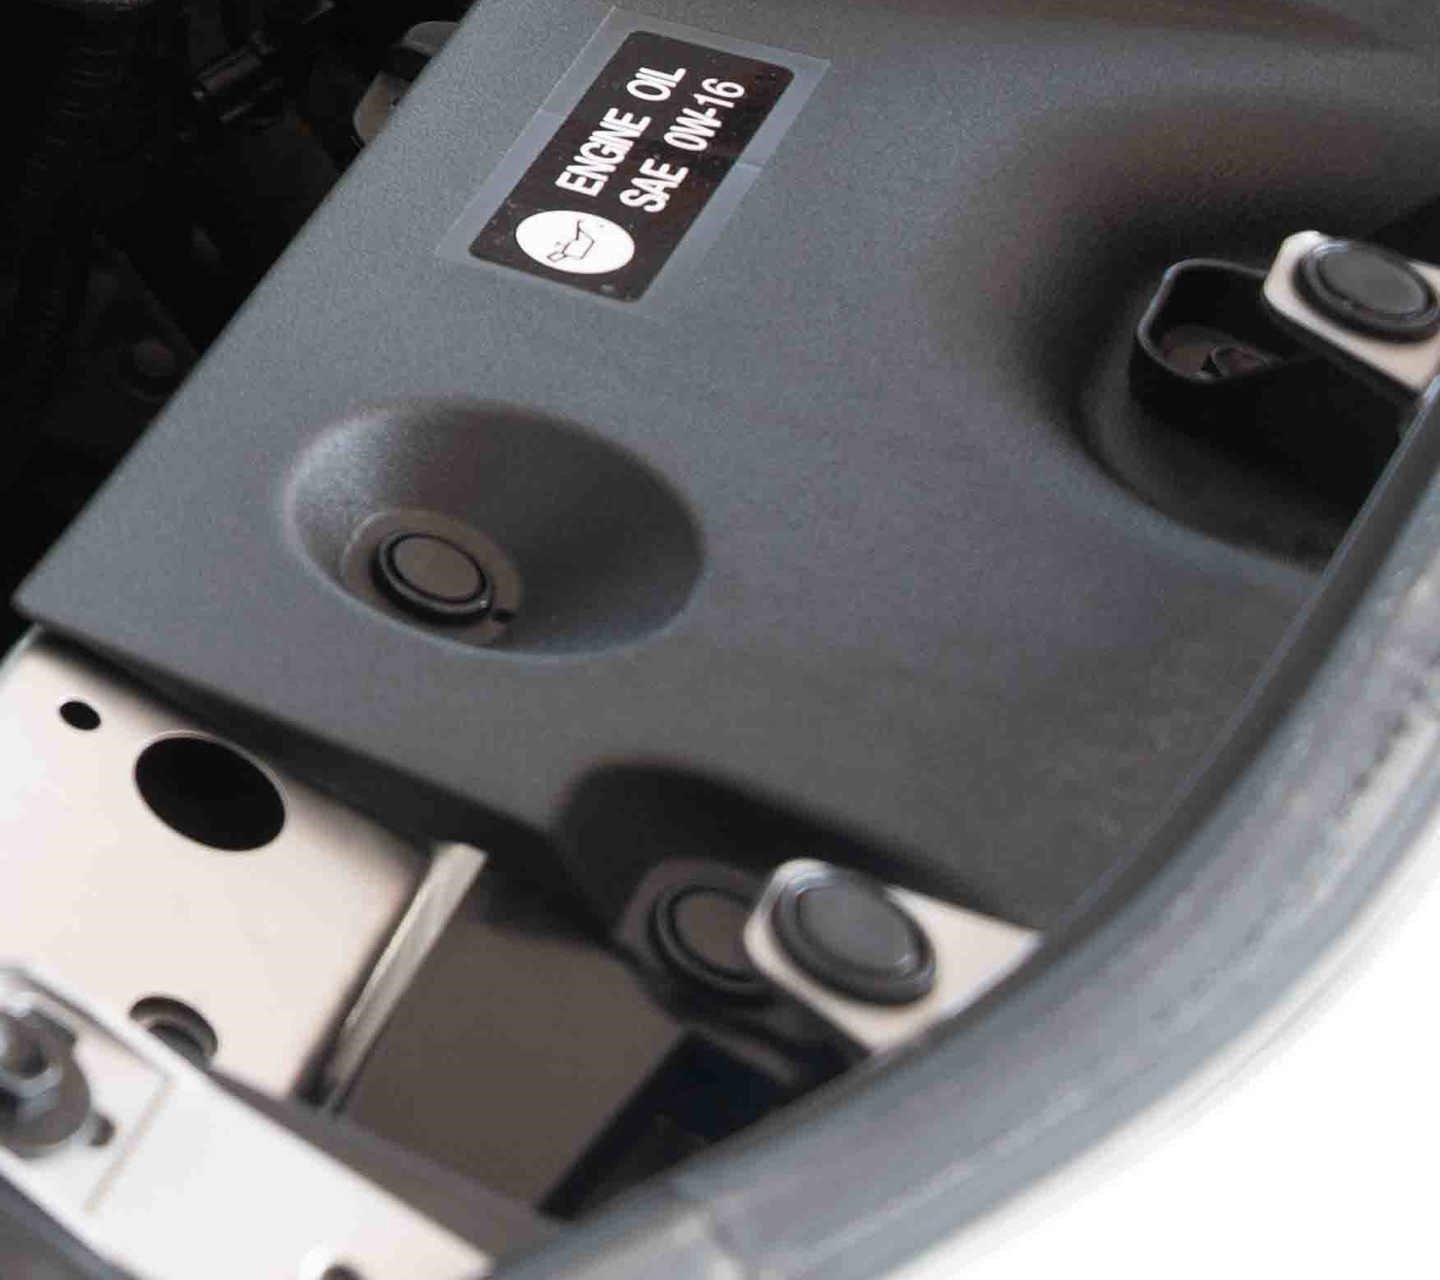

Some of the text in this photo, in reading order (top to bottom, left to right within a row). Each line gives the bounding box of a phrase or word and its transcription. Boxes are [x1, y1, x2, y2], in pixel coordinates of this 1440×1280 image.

[555, 65, 690, 198] ENGINE OIL
[619, 77, 746, 214] SAE 0W-16
